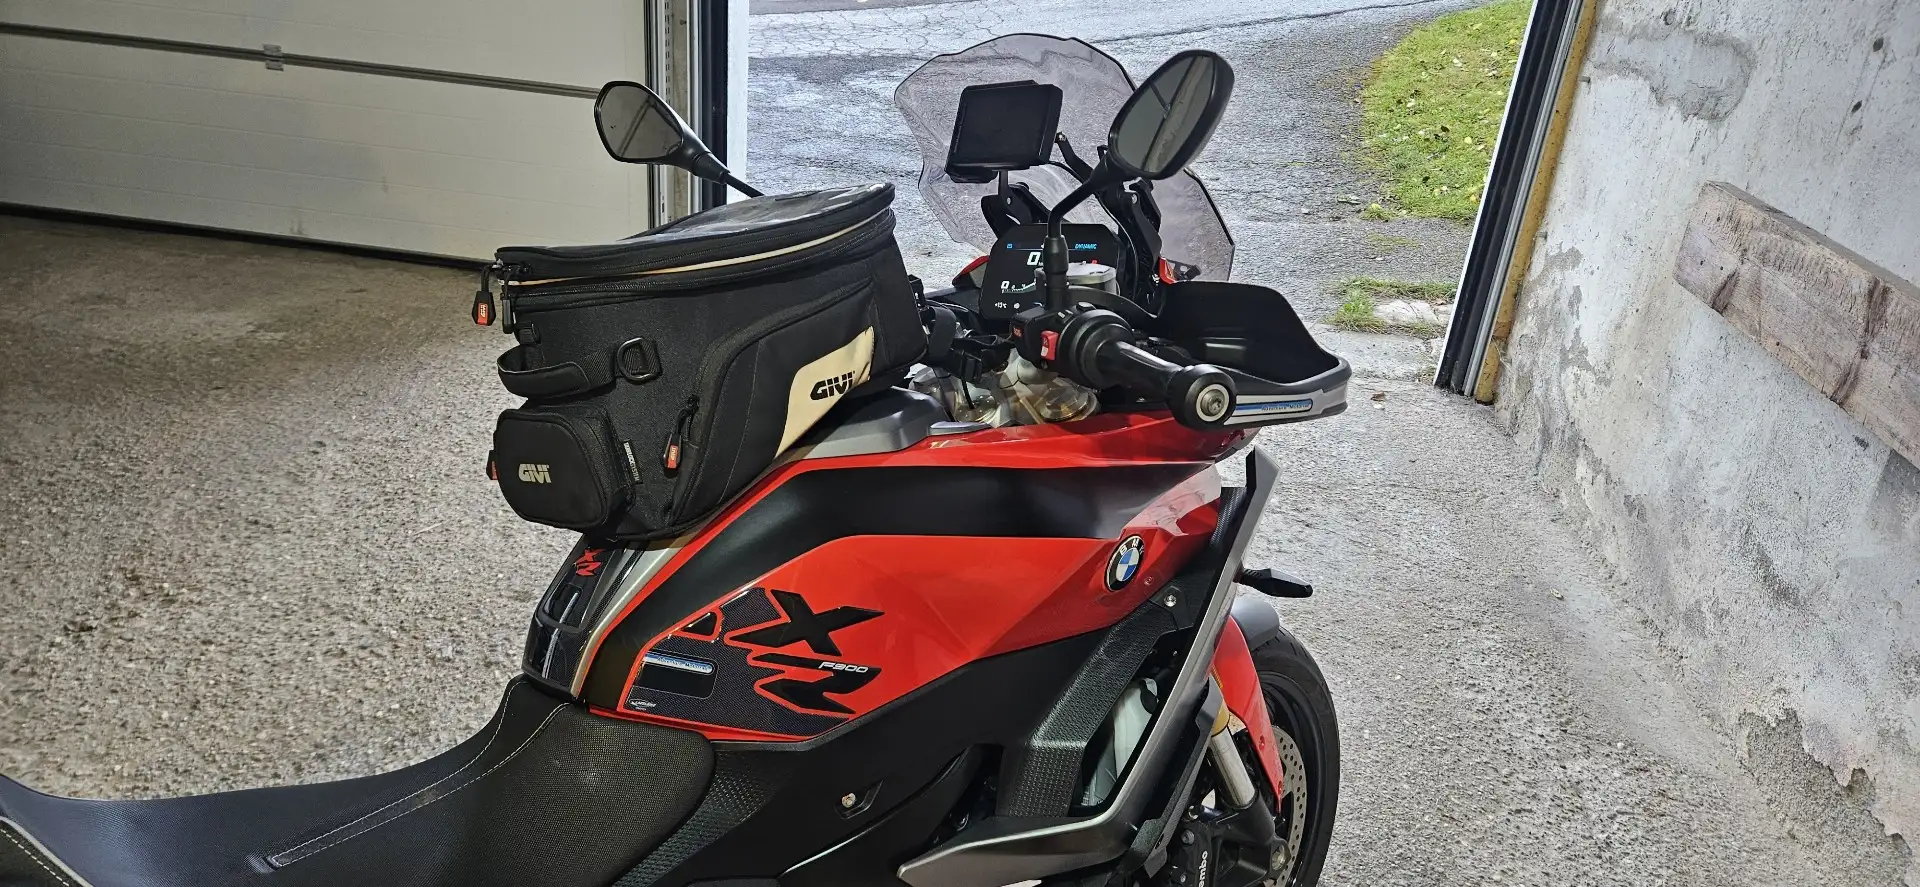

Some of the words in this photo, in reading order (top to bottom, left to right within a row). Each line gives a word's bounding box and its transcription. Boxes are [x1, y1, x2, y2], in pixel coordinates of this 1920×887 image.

[810, 371, 853, 401] GIVI
[518, 463, 552, 484] GIVI
[1119, 538, 1145, 556] BMW
[818, 661, 869, 673] F900
